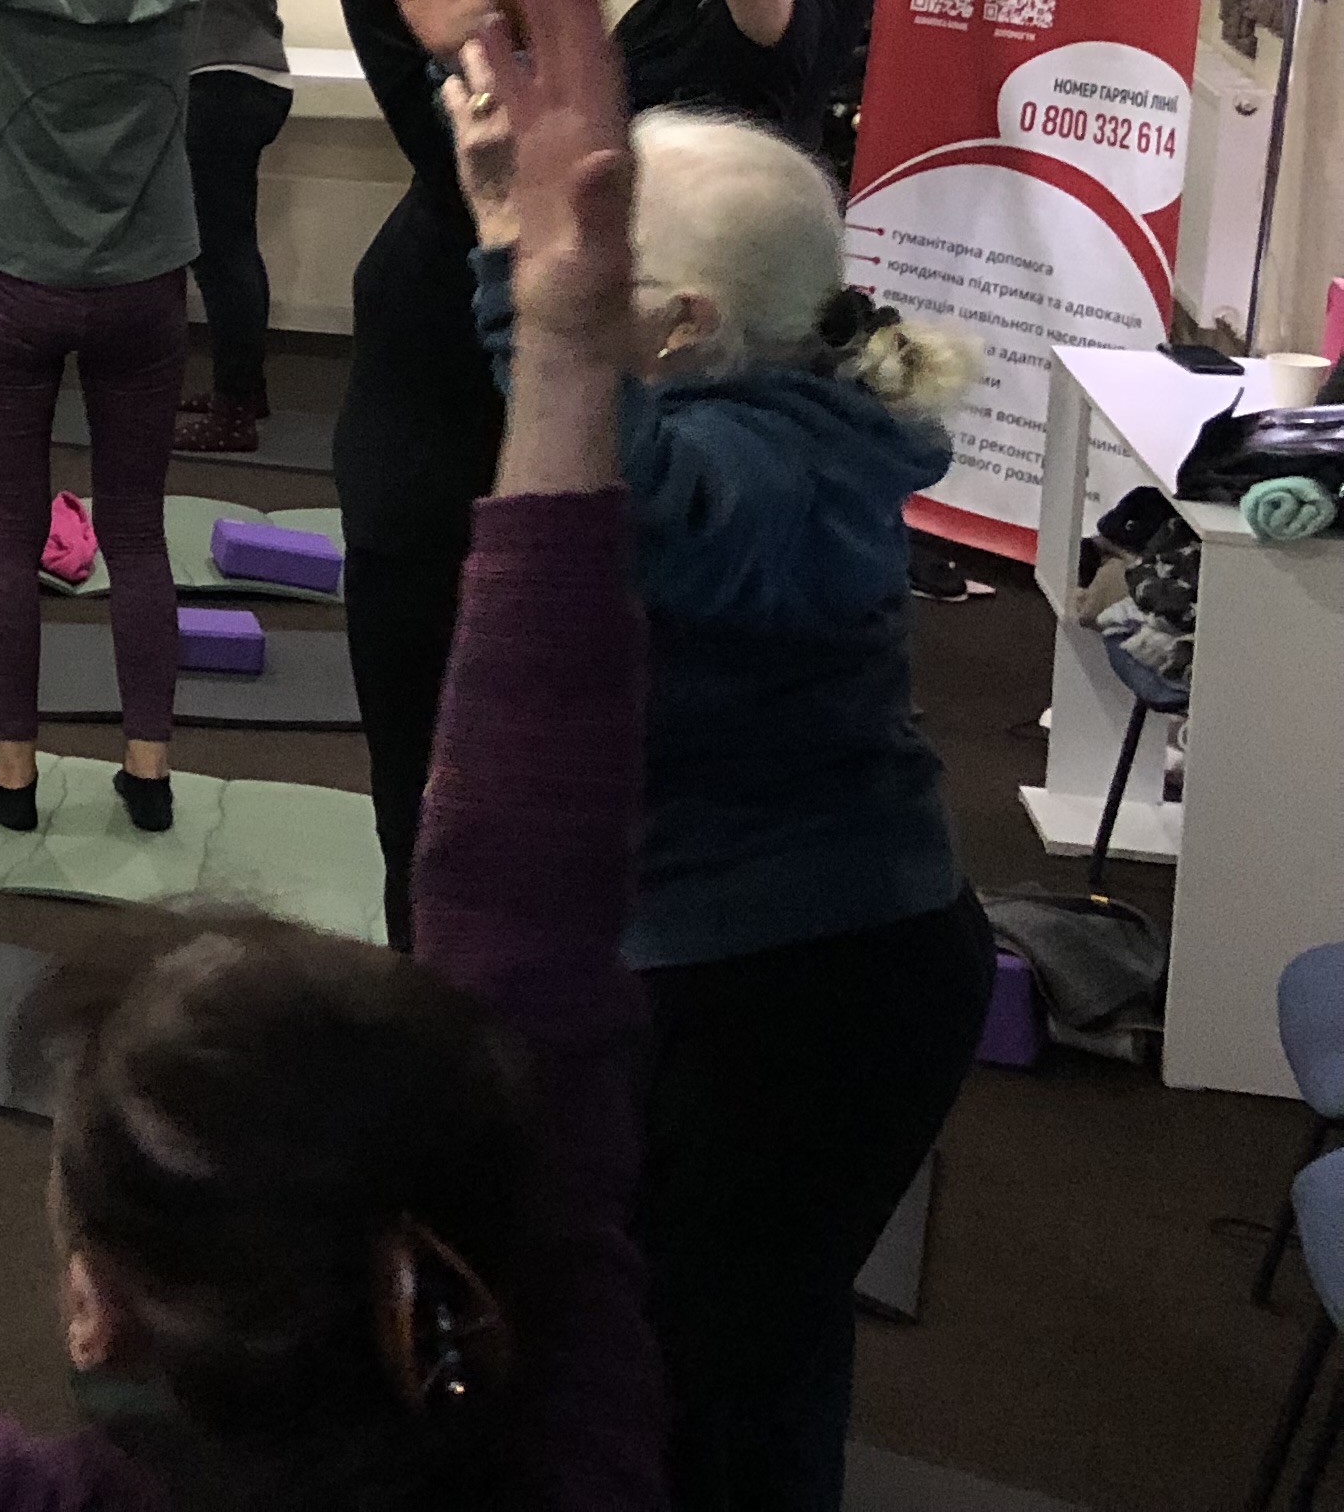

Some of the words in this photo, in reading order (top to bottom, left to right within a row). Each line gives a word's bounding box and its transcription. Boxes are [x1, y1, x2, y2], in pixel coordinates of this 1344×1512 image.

[1053, 78, 1098, 98] НОМЕР
[1099, 85, 1149, 107] ГАРЯЧОЇ
[1150, 94, 1179, 113] ЛІНІЇ
[1019, 101, 1037, 132] 0
[1041, 104, 1087, 141] 800
[1092, 112, 1132, 150] 332
[1136, 121, 1176, 159] 614
[891, 229, 983, 258] гуманітарна
[985, 250, 1054, 276] допомога
[883, 288, 955, 313] евакуація
[958, 306, 1043, 336] цивільного
[887, 259, 964, 287] юридична
[968, 276, 1044, 305] підтримка
[1047, 295, 1062, 309] та
[1065, 301, 1143, 329] адвокація
[999, 348, 1052, 370] адапта
[960, 432, 976, 446] та
